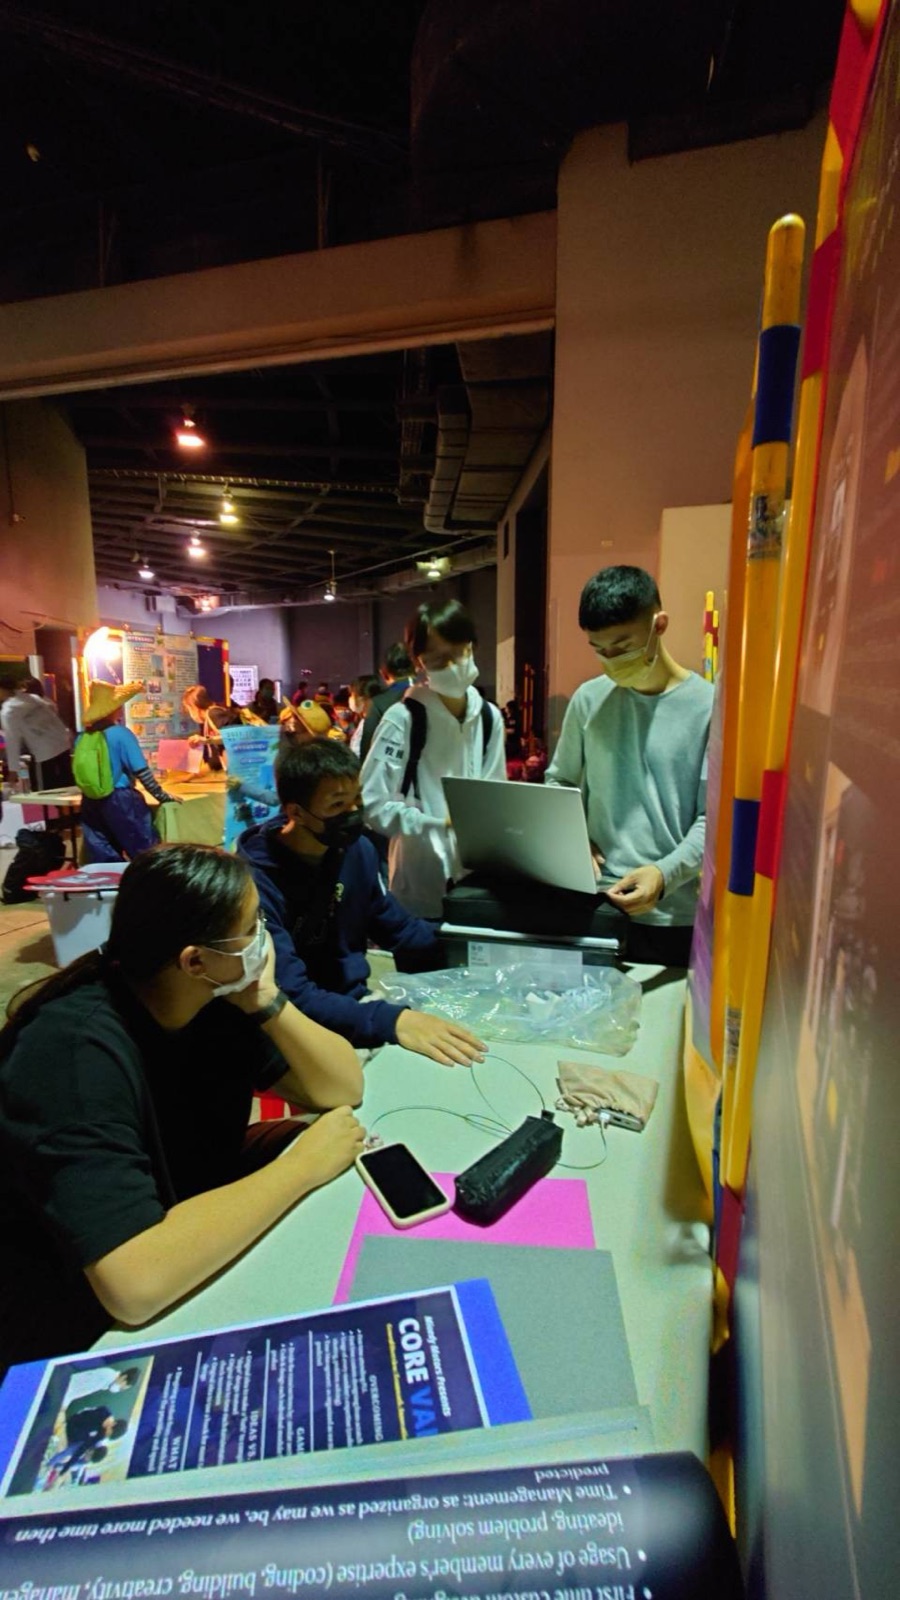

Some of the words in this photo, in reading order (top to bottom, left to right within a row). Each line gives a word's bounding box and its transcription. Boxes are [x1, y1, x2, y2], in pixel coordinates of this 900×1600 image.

[398, 1317, 430, 1384] CORE
[430, 1345, 444, 1376] Motors
[436, 1376, 452, 1417] Presents
[246, 1409, 259, 1441] IDEAS
[168, 1435, 182, 1470] WHAT
[295, 1426, 305, 1454] GAM
[534, 1464, 610, 1484] predicted
[442, 1495, 460, 1508] as
[462, 1486, 574, 1508] Management:
[574, 1483, 618, 1501] Time
[215, 1512, 241, 1526] we
[244, 1510, 270, 1526] be,
[271, 1505, 308, 1521] may
[310, 1505, 335, 1518] we
[337, 1503, 356, 1516] as
[358, 1494, 440, 1520] organized
[57, 1523, 99, 1540] time
[100, 1520, 148, 1536] more
[147, 1514, 214, 1536] needed
[407, 1518, 475, 1546] solving)
[478, 1510, 549, 1541] problem
[550, 1509, 625, 1535] ideating,
[14, 1527, 58, 1545] then
[508, 1547, 554, 1571] every
[555, 1551, 577, 1577] of
[578, 1541, 632, 1570] Usage
[261, 1562, 334, 1594] (coding,
[336, 1554, 417, 1588] expertise
[419, 1555, 504, 1583] member's
[84, 1576, 172, 1600] creativity,
[177, 1569, 257, 1600] building,
